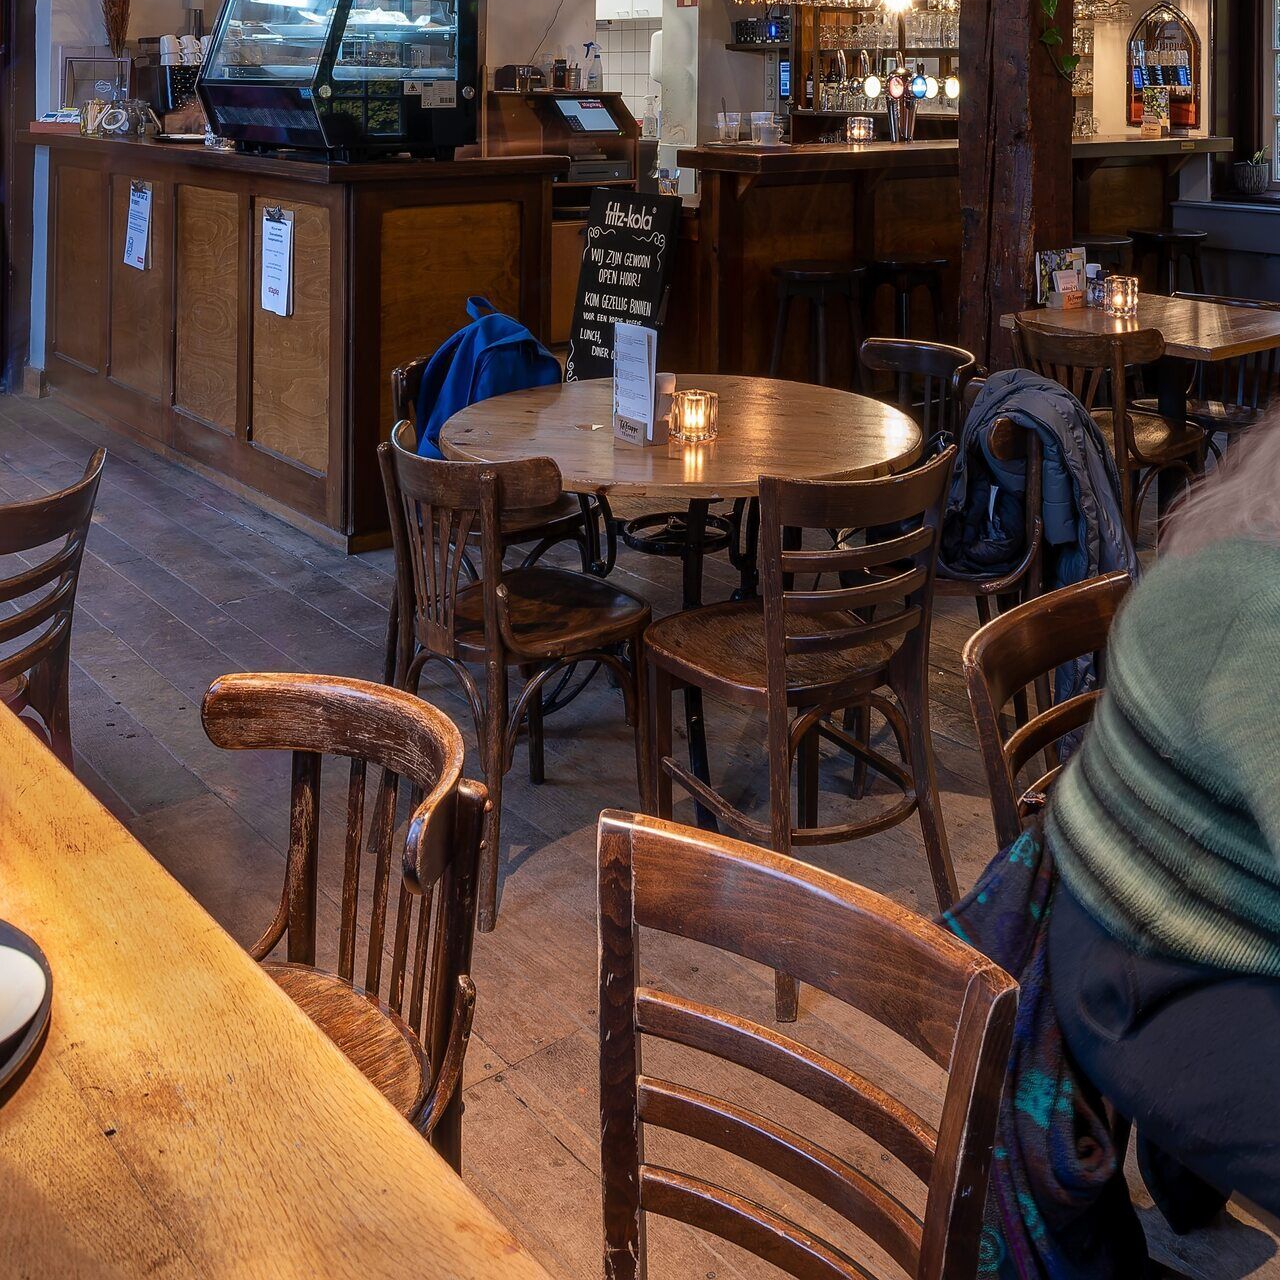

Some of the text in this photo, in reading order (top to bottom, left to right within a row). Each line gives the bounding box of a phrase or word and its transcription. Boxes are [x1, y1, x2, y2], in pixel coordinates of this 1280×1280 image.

[605, 201, 654, 231] fritz-kola
[590, 247, 651, 269] WIJ ZIJN GEWOON
[598, 268, 642, 288] OPEN HOOR!
[584, 291, 652, 318] KOM GEZELLIG BINNEN
[582, 311, 608, 322] VOOR EEN
[591, 344, 610, 359] DINER
